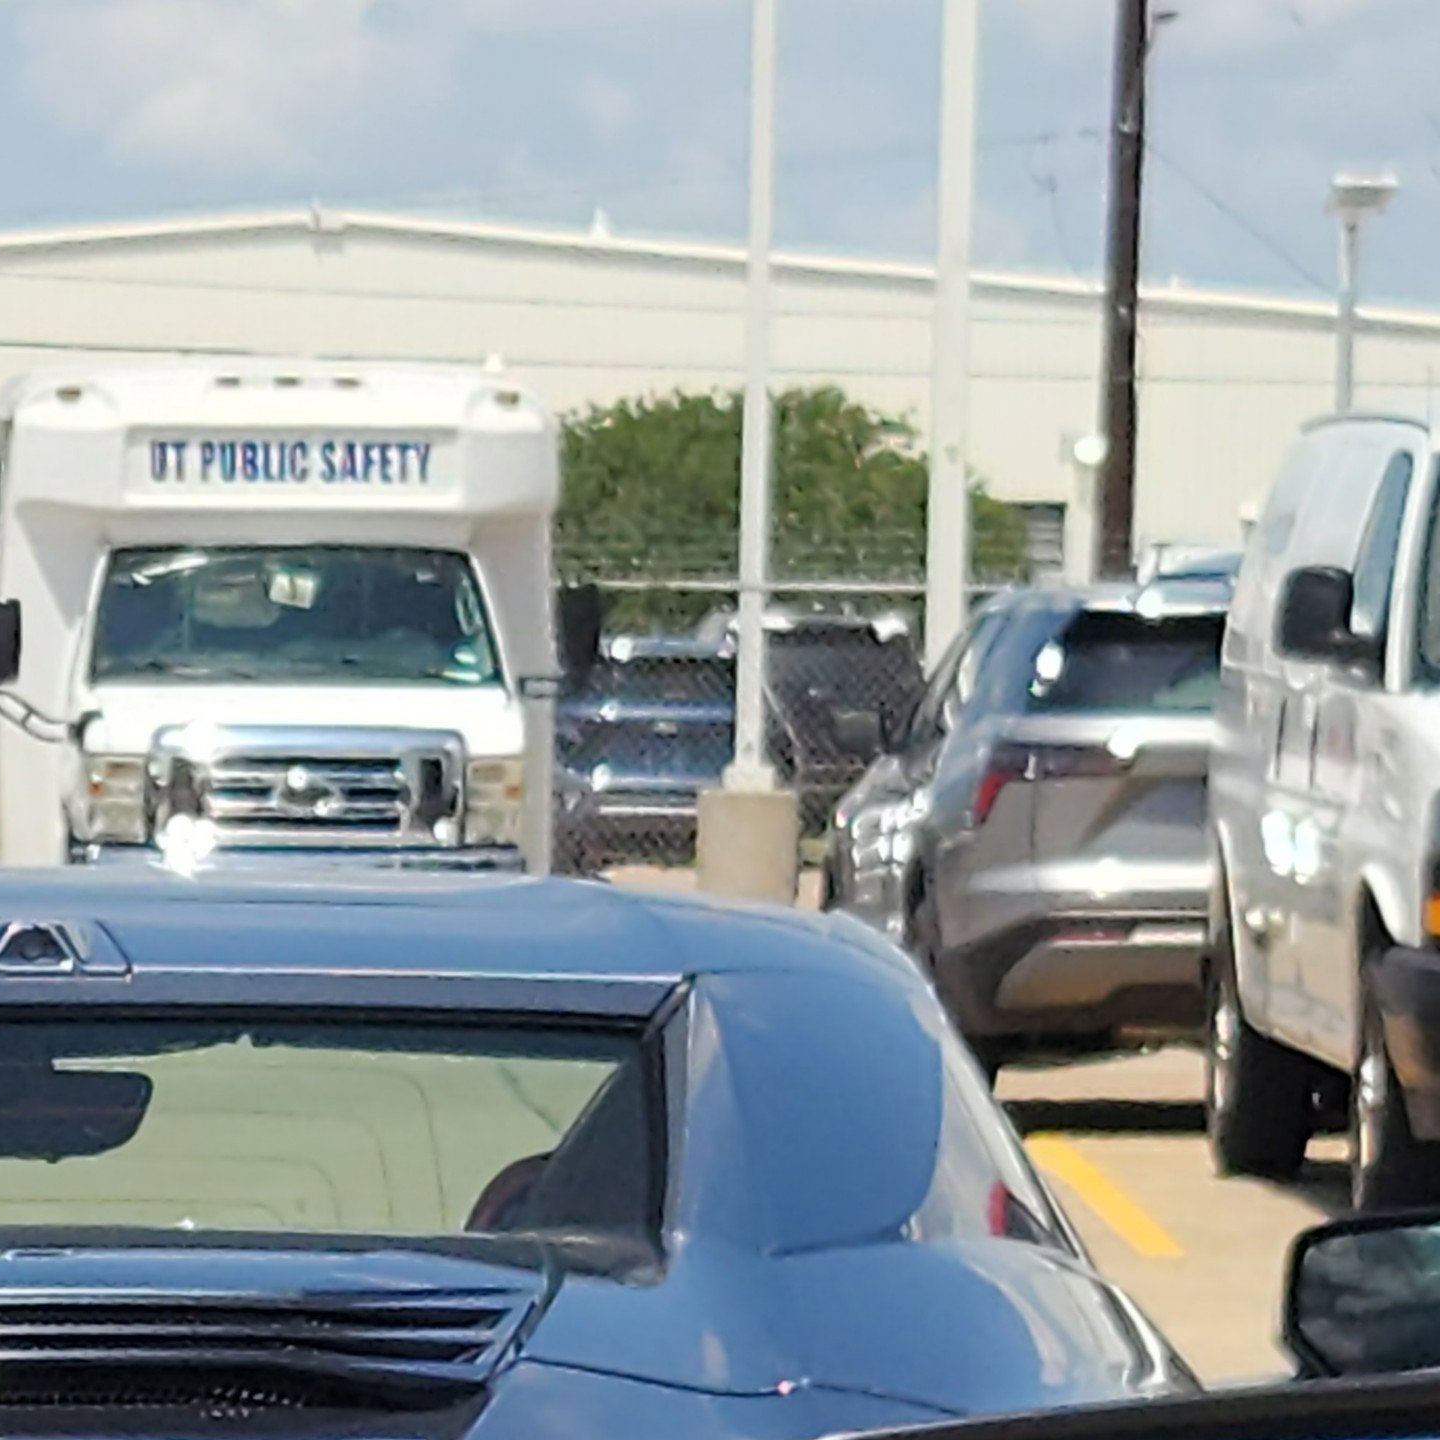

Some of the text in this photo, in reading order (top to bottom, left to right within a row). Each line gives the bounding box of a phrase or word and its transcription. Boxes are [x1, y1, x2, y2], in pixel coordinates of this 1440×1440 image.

[150, 440, 431, 484] UT PUBLIC SAFETY
